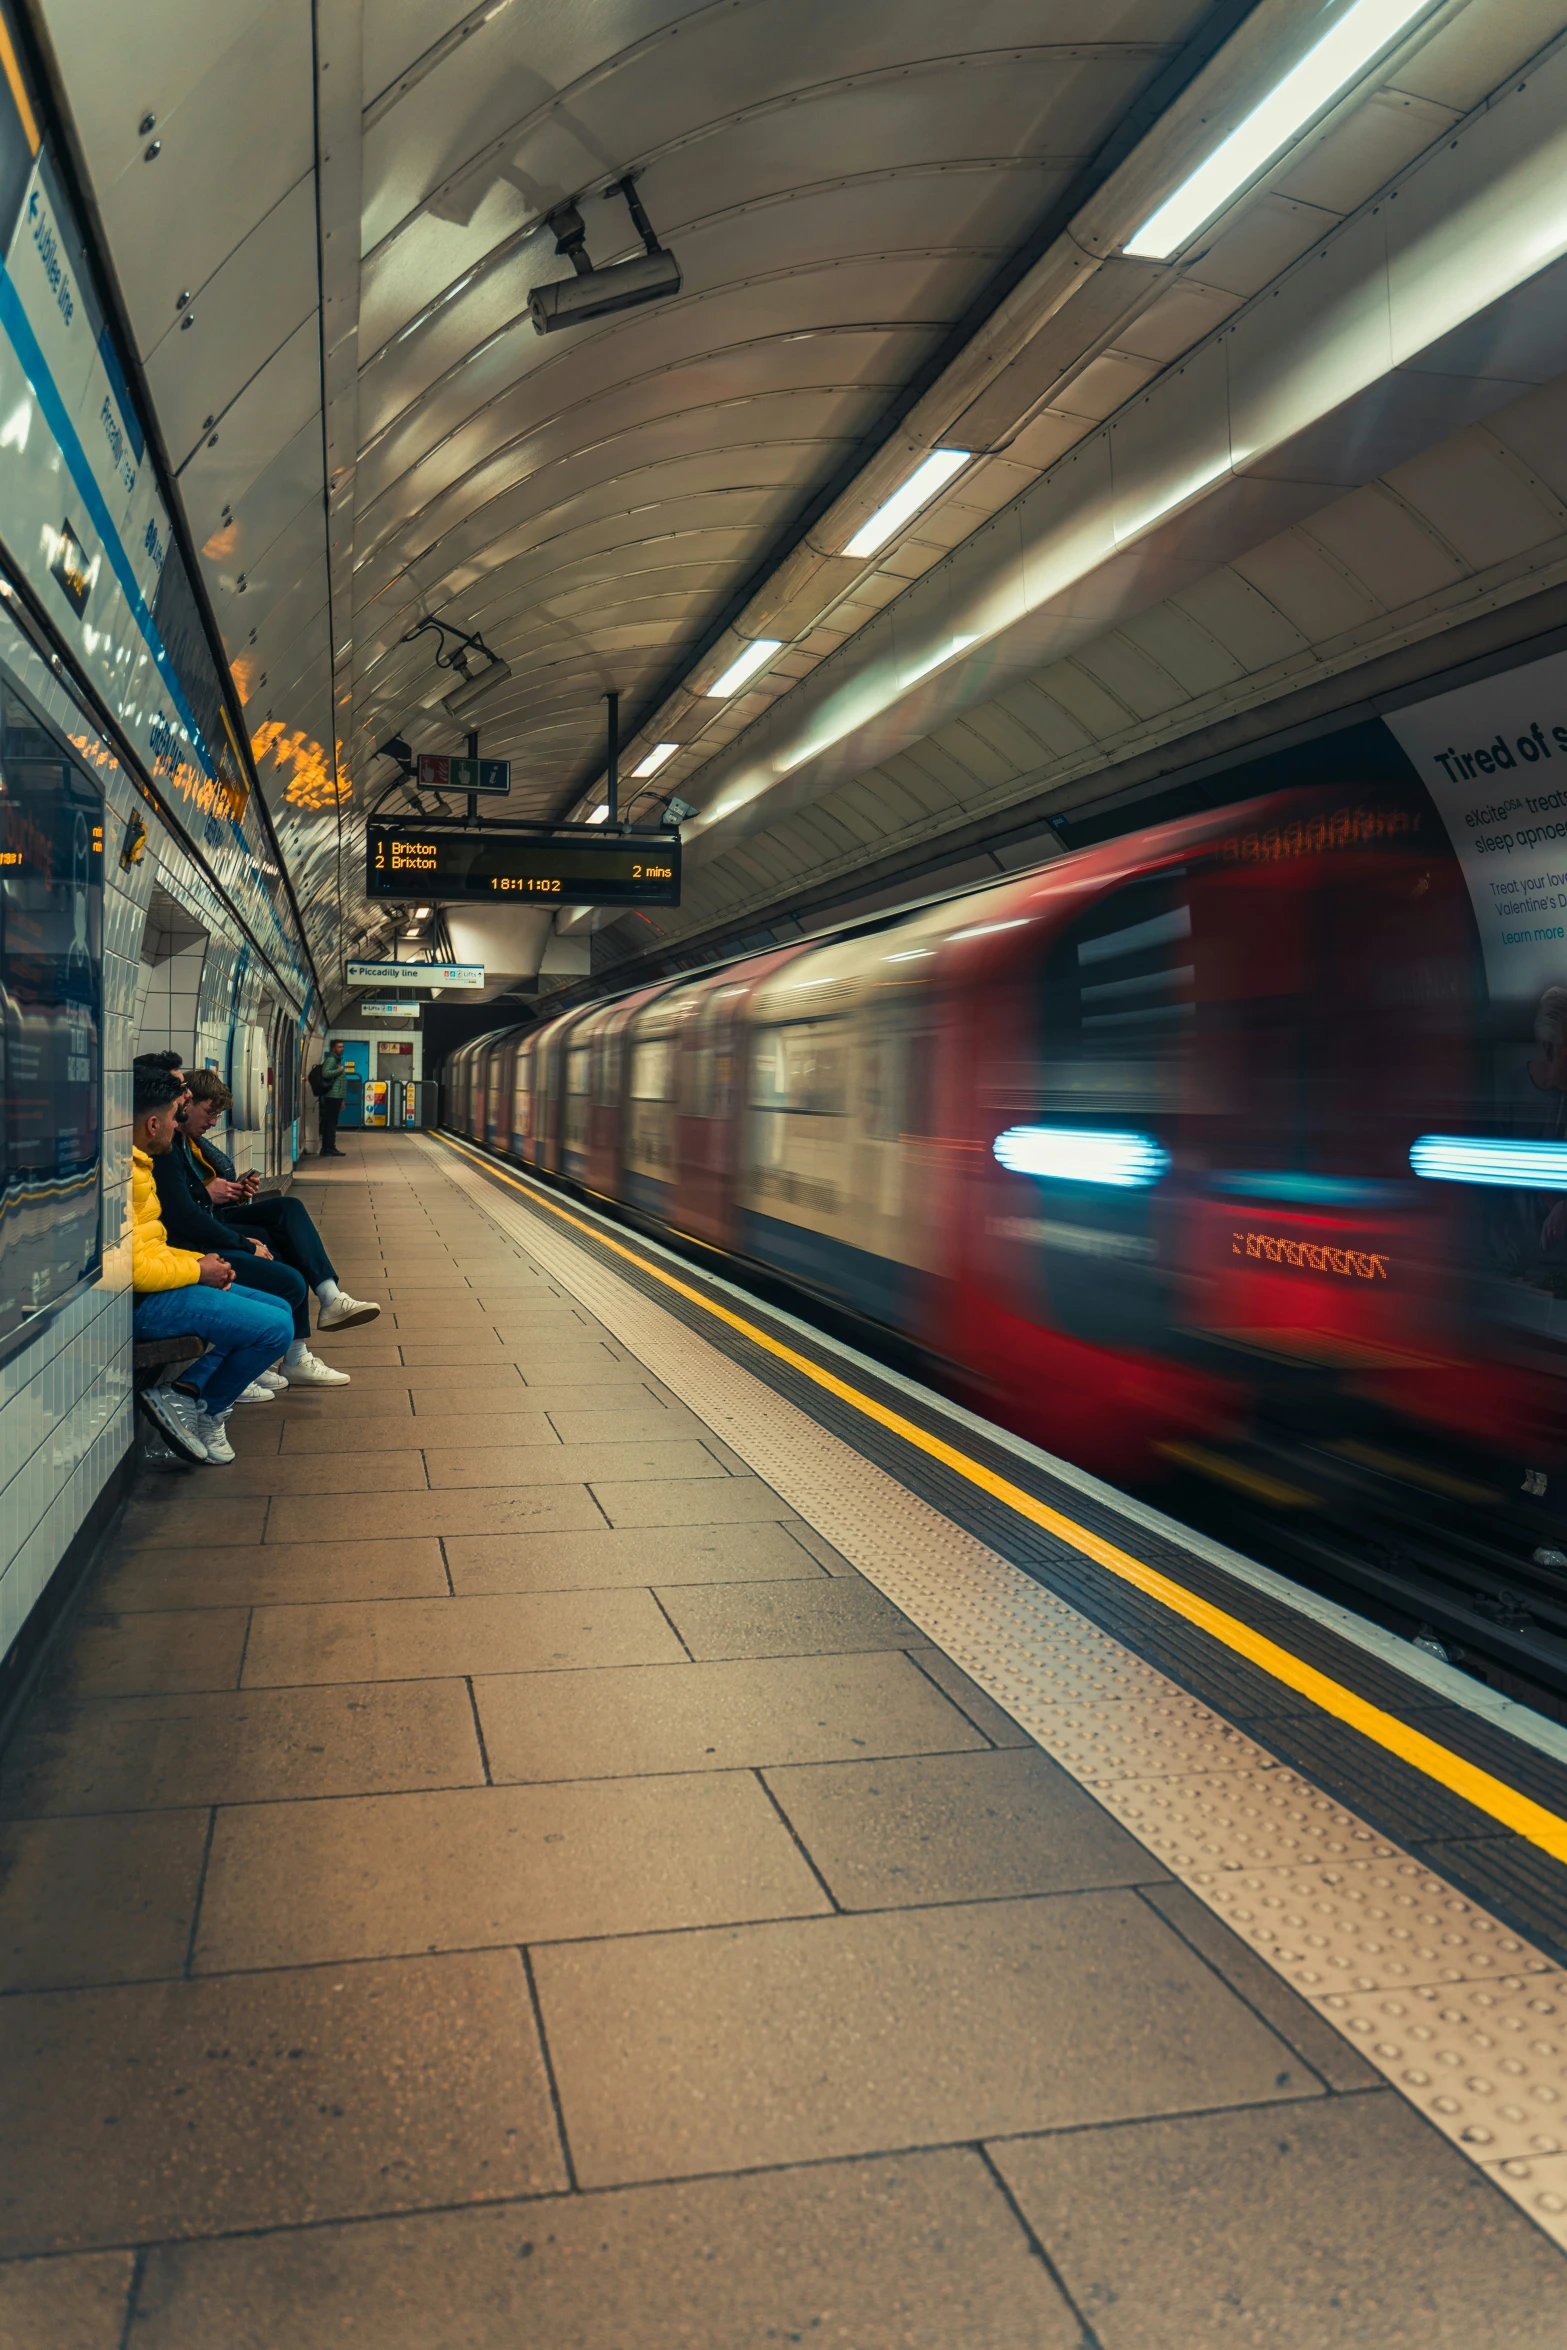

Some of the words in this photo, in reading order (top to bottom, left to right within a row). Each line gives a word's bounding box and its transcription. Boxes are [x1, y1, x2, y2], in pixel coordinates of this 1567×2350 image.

[33, 210, 61, 294] Jubilee
[57, 273, 74, 327] line
[1433, 735, 1518, 783] Tired
[1517, 722, 1552, 763] of
[377, 841, 383, 854] 1
[391, 842, 437, 855] Brixton
[1475, 835, 1514, 854] sleep
[1516, 822, 1567, 849] apnoe
[375, 855, 385, 868] 2
[391, 856, 437, 869] Brixton
[632, 865, 642, 878] 2
[646, 866, 672, 878] mins
[491, 878, 561, 891] 18:11:02
[1489, 880, 1519, 896] Treat
[1520, 876, 1545, 896] your
[1495, 895, 1556, 916] Valentine's
[1502, 931, 1532, 945] Learn
[1534, 926, 1565, 941] more
[359, 967, 399, 978] Piccadilly
[402, 969, 418, 977] line
